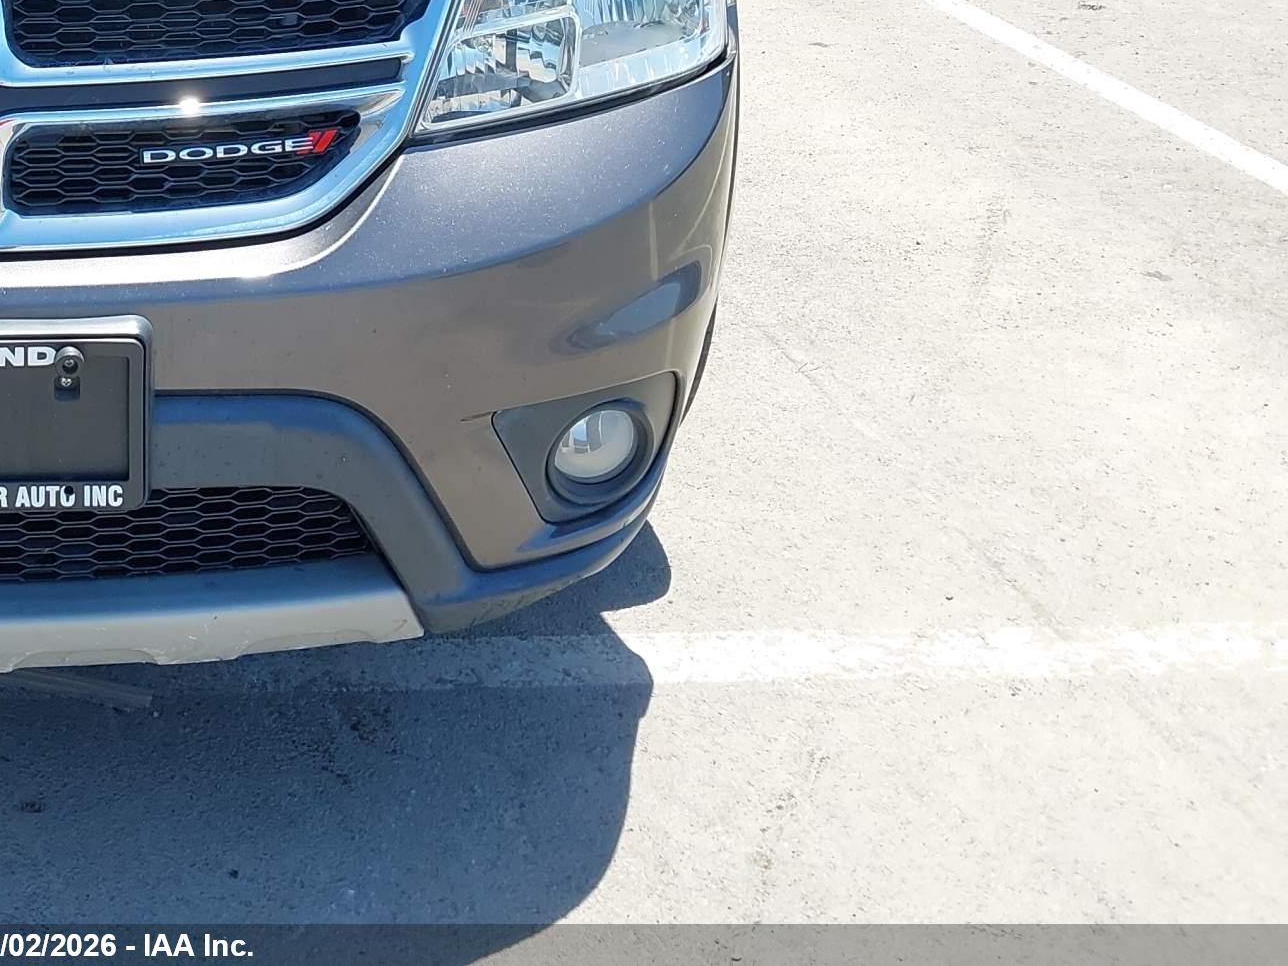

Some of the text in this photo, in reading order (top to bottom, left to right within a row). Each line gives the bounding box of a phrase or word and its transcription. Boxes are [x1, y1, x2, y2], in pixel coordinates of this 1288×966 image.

[142, 136, 314, 164] DODGE
[14, 485, 76, 508] AUTO
[83, 483, 124, 508] INC
